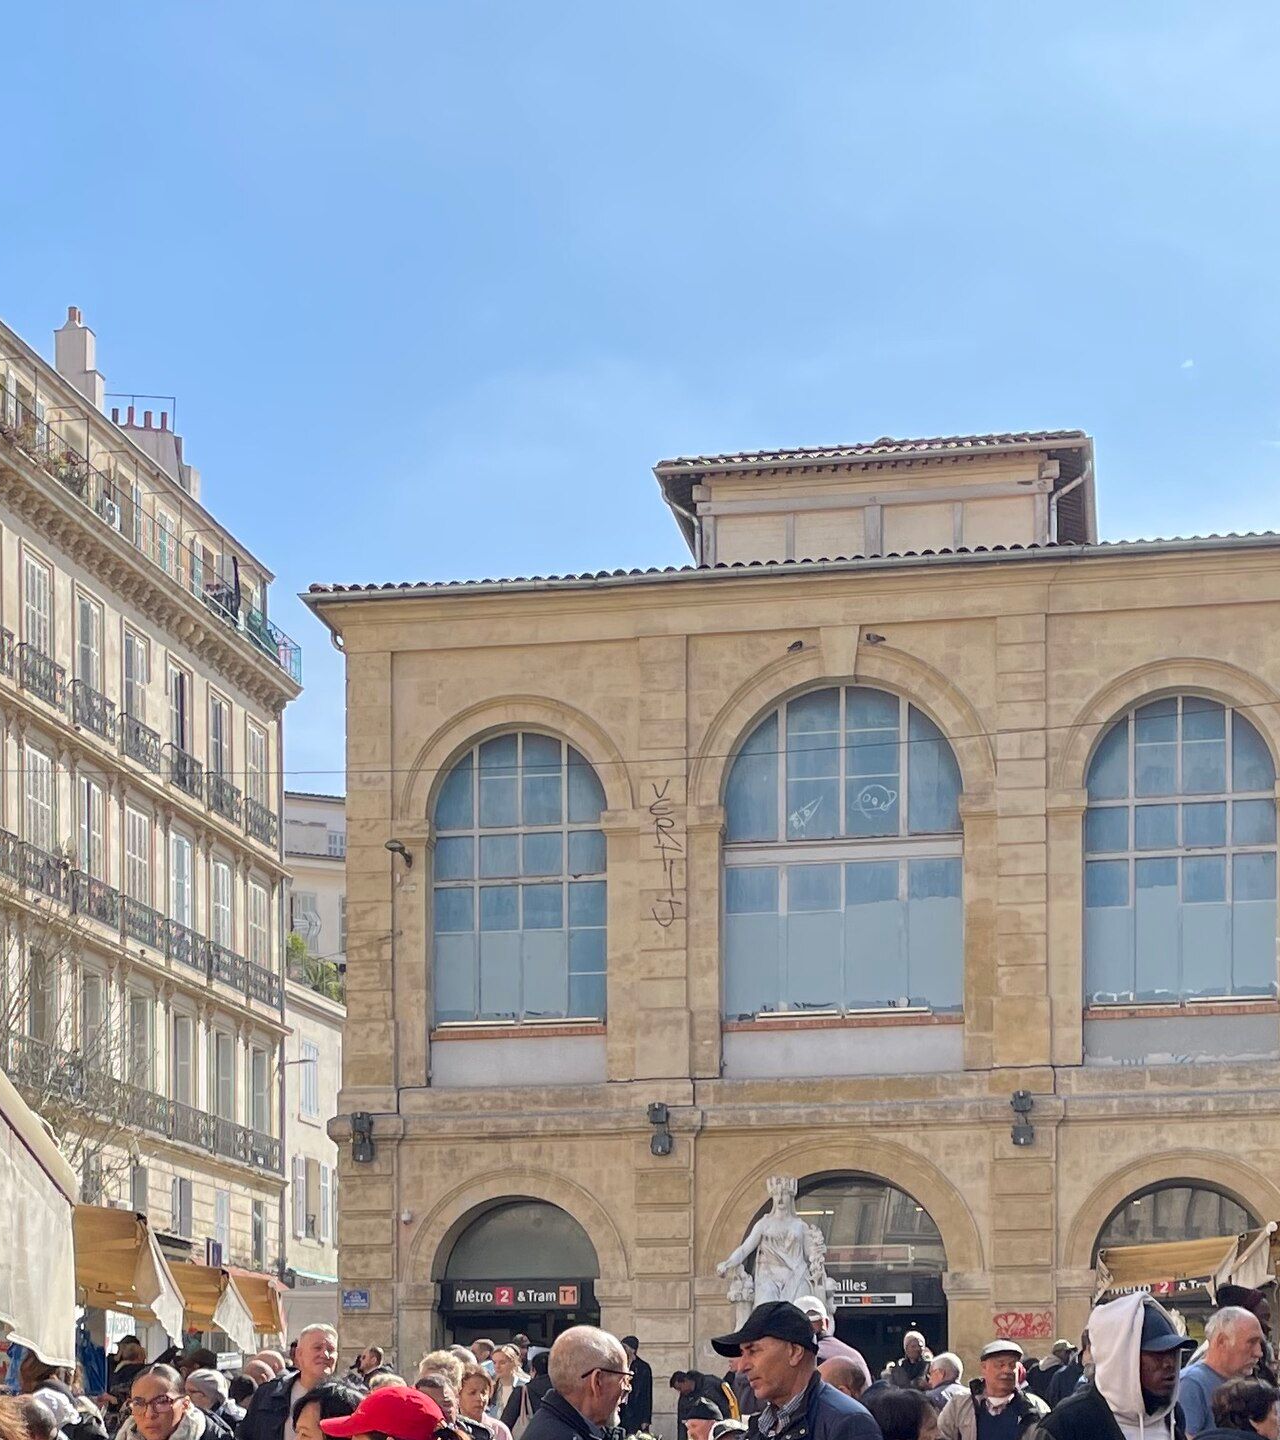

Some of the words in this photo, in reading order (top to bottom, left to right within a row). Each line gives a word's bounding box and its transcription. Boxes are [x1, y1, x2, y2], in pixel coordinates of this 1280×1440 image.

[834, 1278, 868, 1292] ailles
[1159, 1281, 1170, 1294] 2
[455, 1288, 494, 1304] Métro
[499, 1289, 510, 1303] 2
[517, 1290, 527, 1303] &
[527, 1289, 557, 1303] Tram
[560, 1288, 577, 1304] T1
